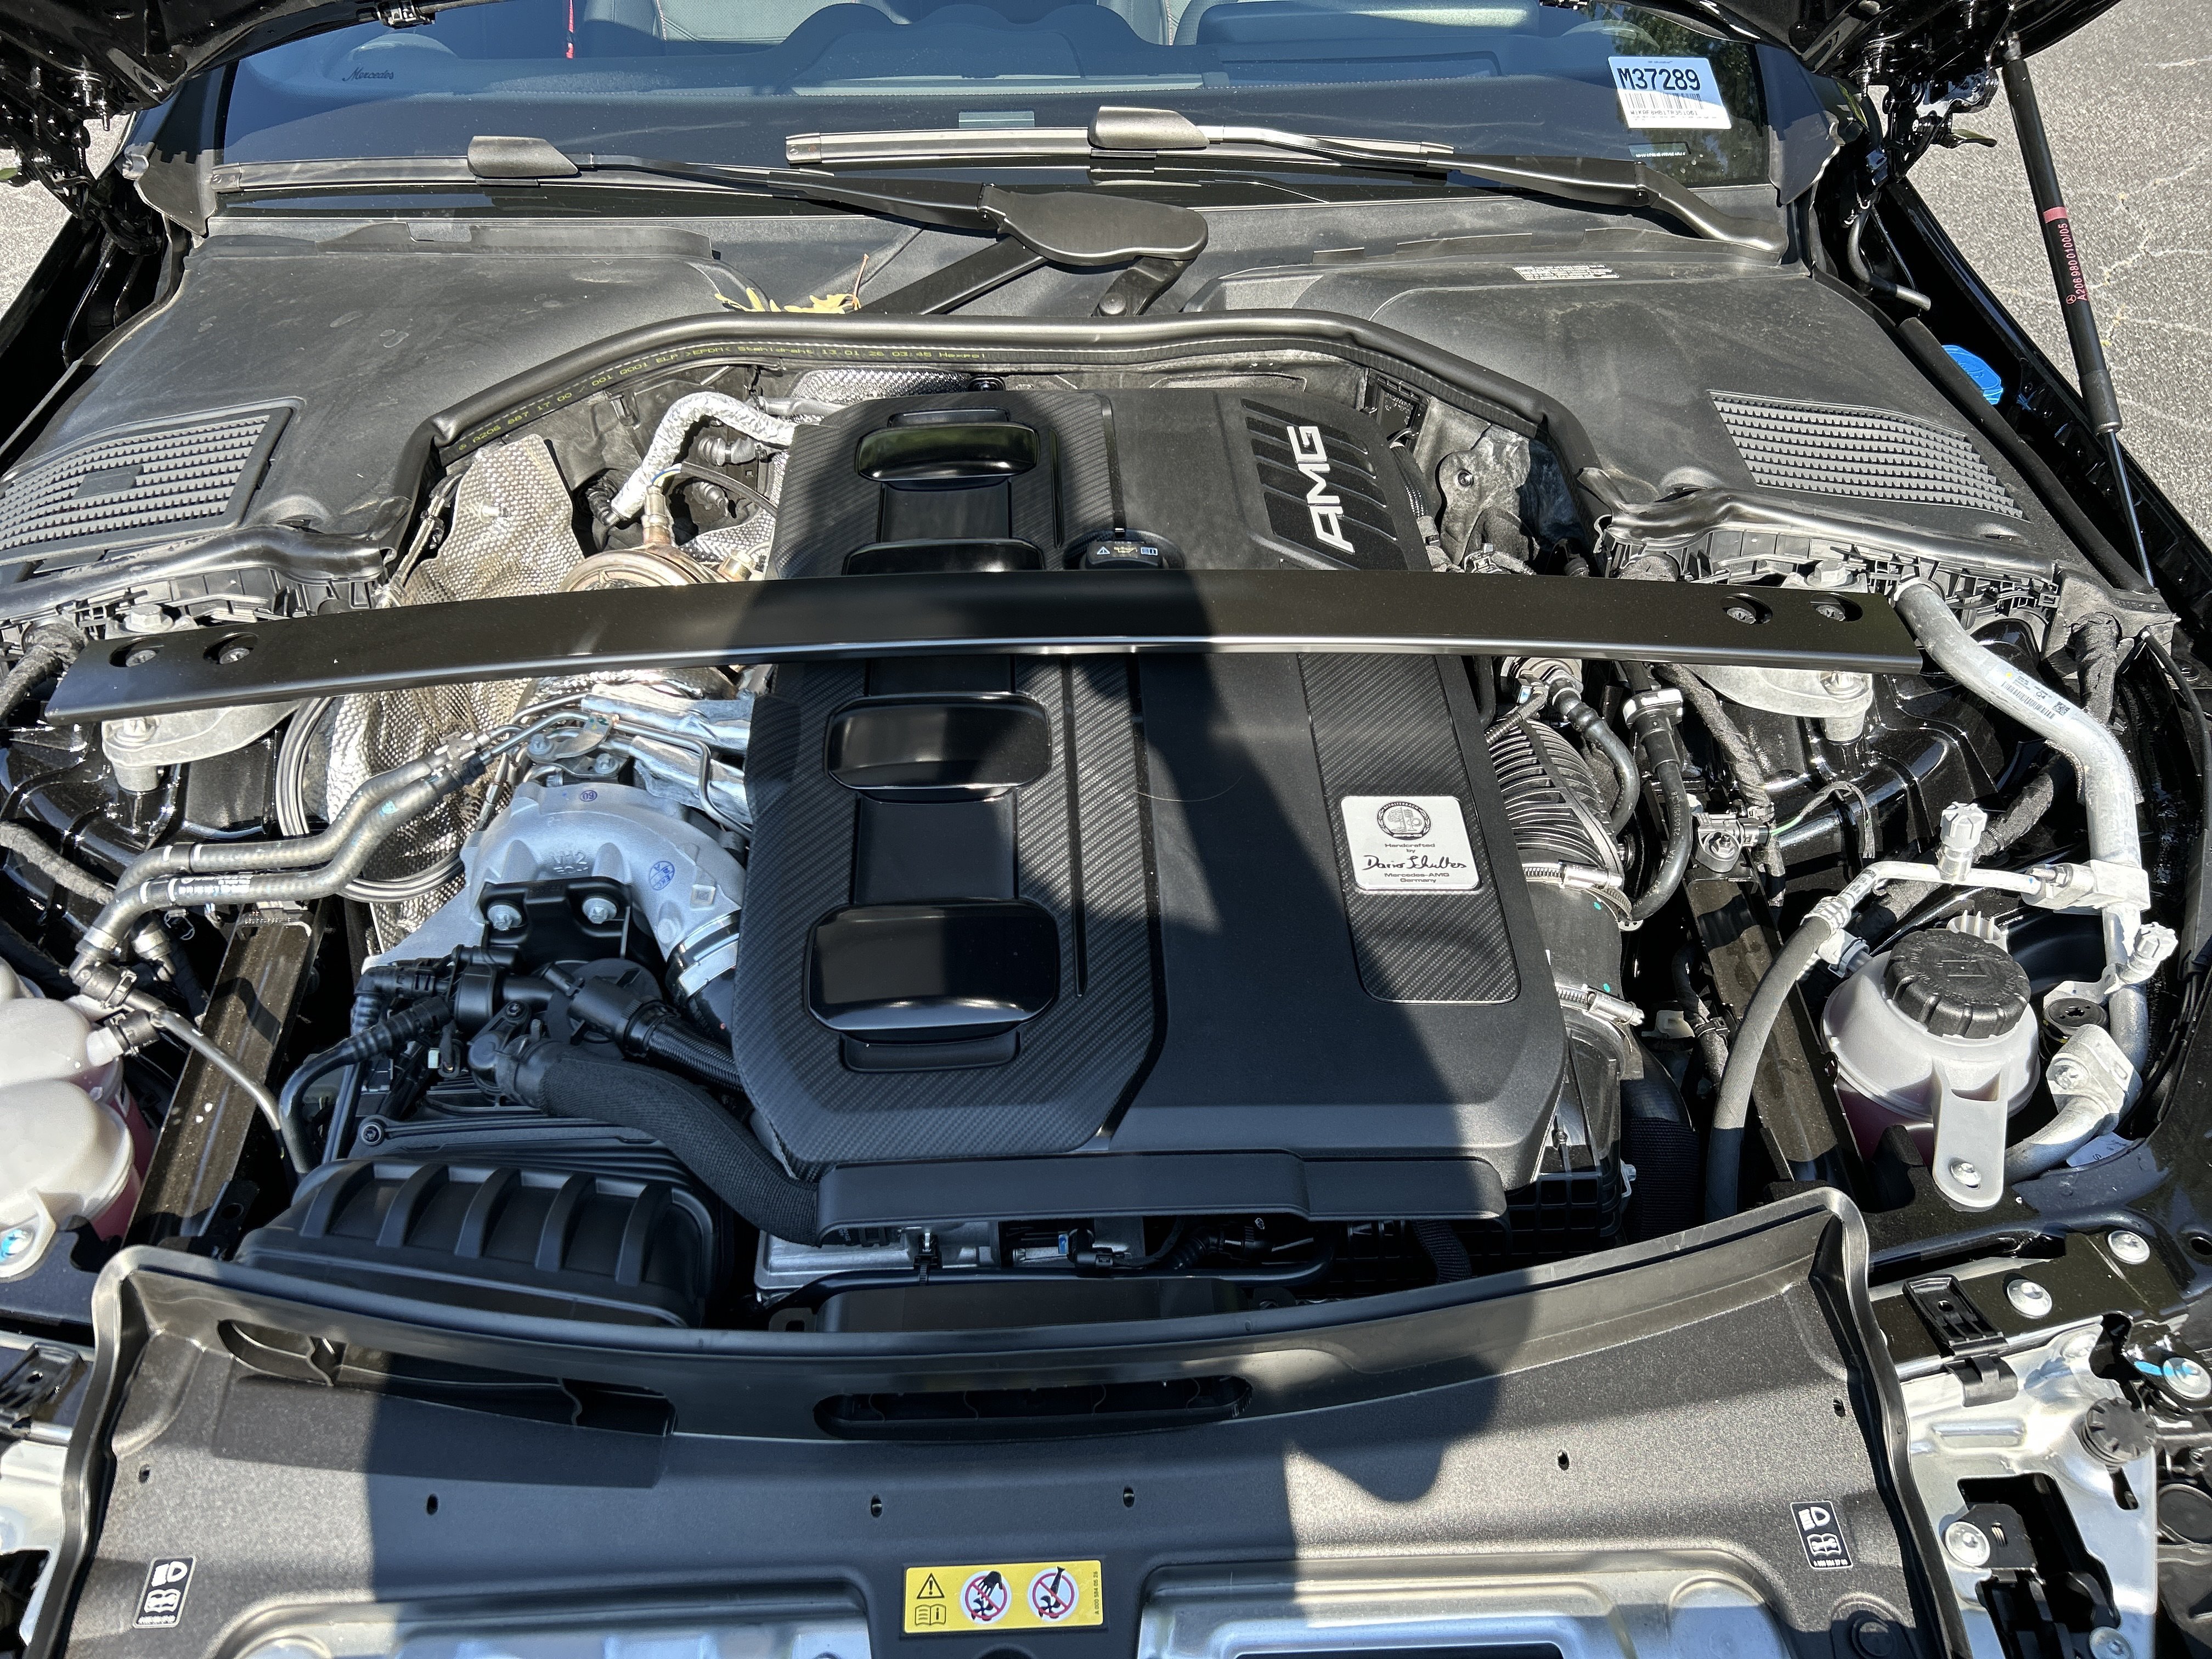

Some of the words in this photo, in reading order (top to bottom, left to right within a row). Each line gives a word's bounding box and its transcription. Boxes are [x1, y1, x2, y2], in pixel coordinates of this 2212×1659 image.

[342, 66, 394, 82] Mercedes
[1616, 67, 1701, 92] M37289
[2057, 223, 2076, 259] 0100/05
[2067, 259, 2081, 276] 980
[2072, 277, 2088, 301] A206
[1286, 426, 1355, 554] AMG
